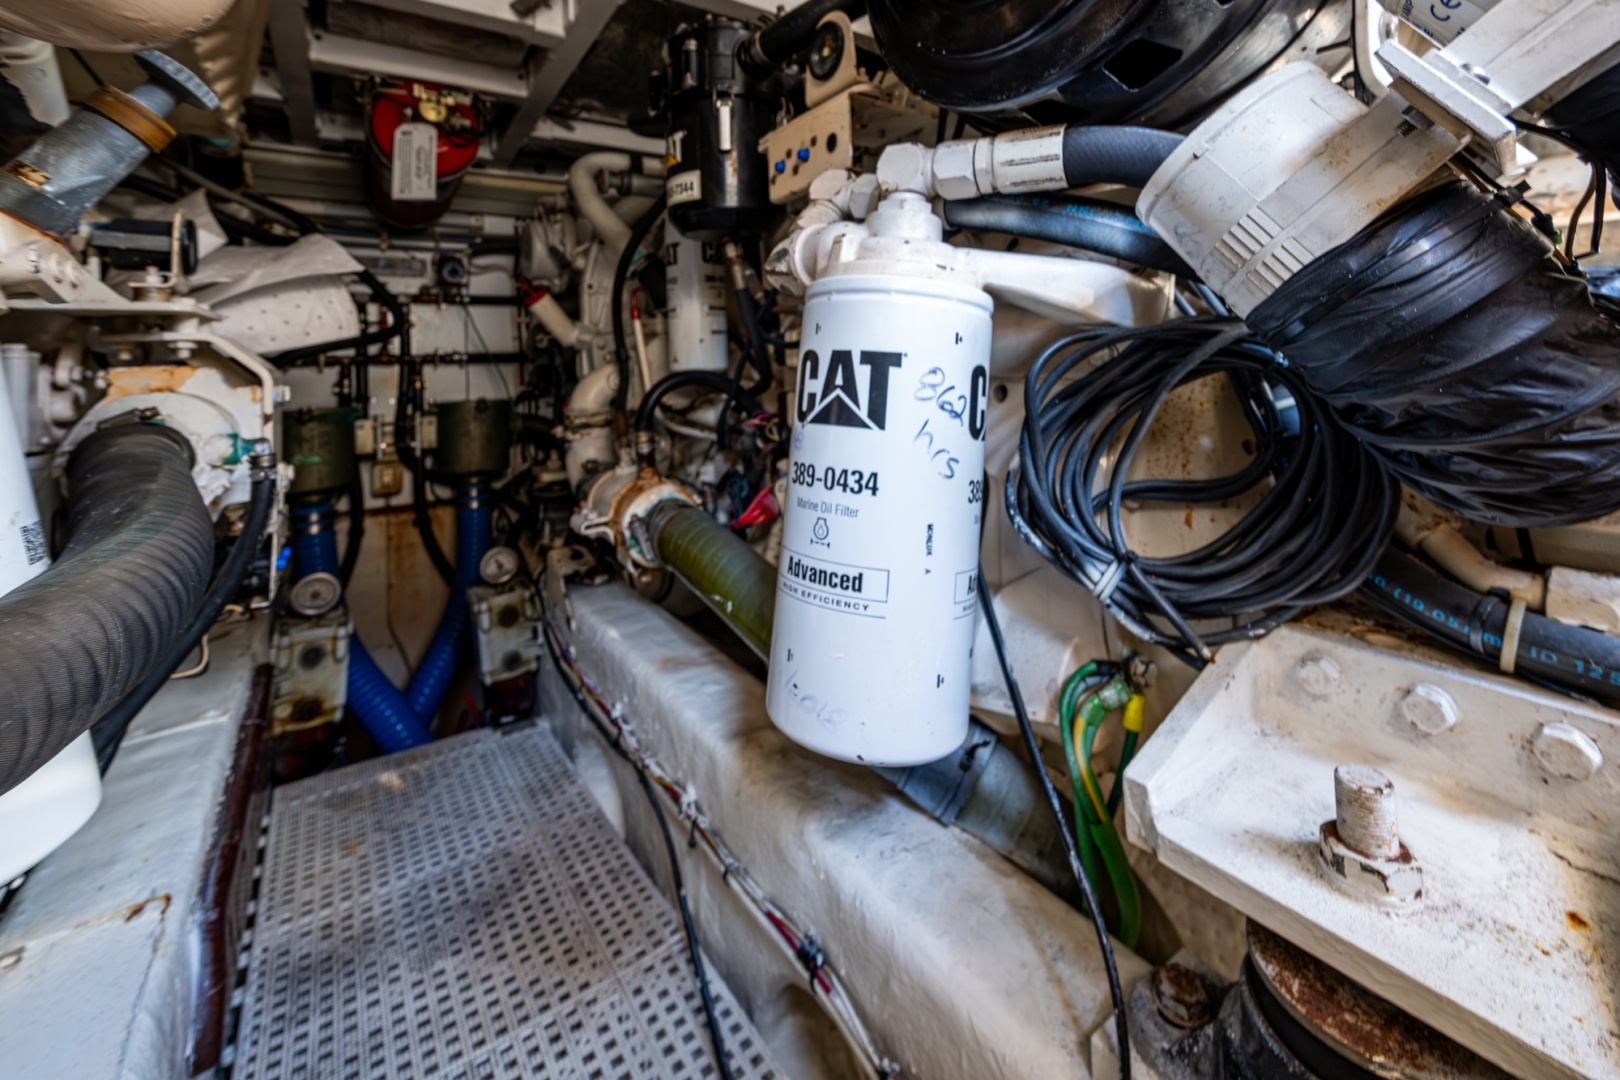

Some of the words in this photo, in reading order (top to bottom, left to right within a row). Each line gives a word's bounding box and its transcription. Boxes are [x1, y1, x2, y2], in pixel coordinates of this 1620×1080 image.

[797, 349, 903, 431] CAT
[914, 366, 967, 427] 862
[969, 364, 986, 441] C
[914, 418, 960, 480] hrs
[792, 461, 879, 497] 389-0434
[797, 497, 819, 513] Marine
[821, 501, 833, 515] Oil
[835, 505, 860, 519] Filter
[783, 581, 799, 594] HIGH
[801, 589, 870, 612] EFFICIENCY
[787, 555, 864, 593] Advanced
